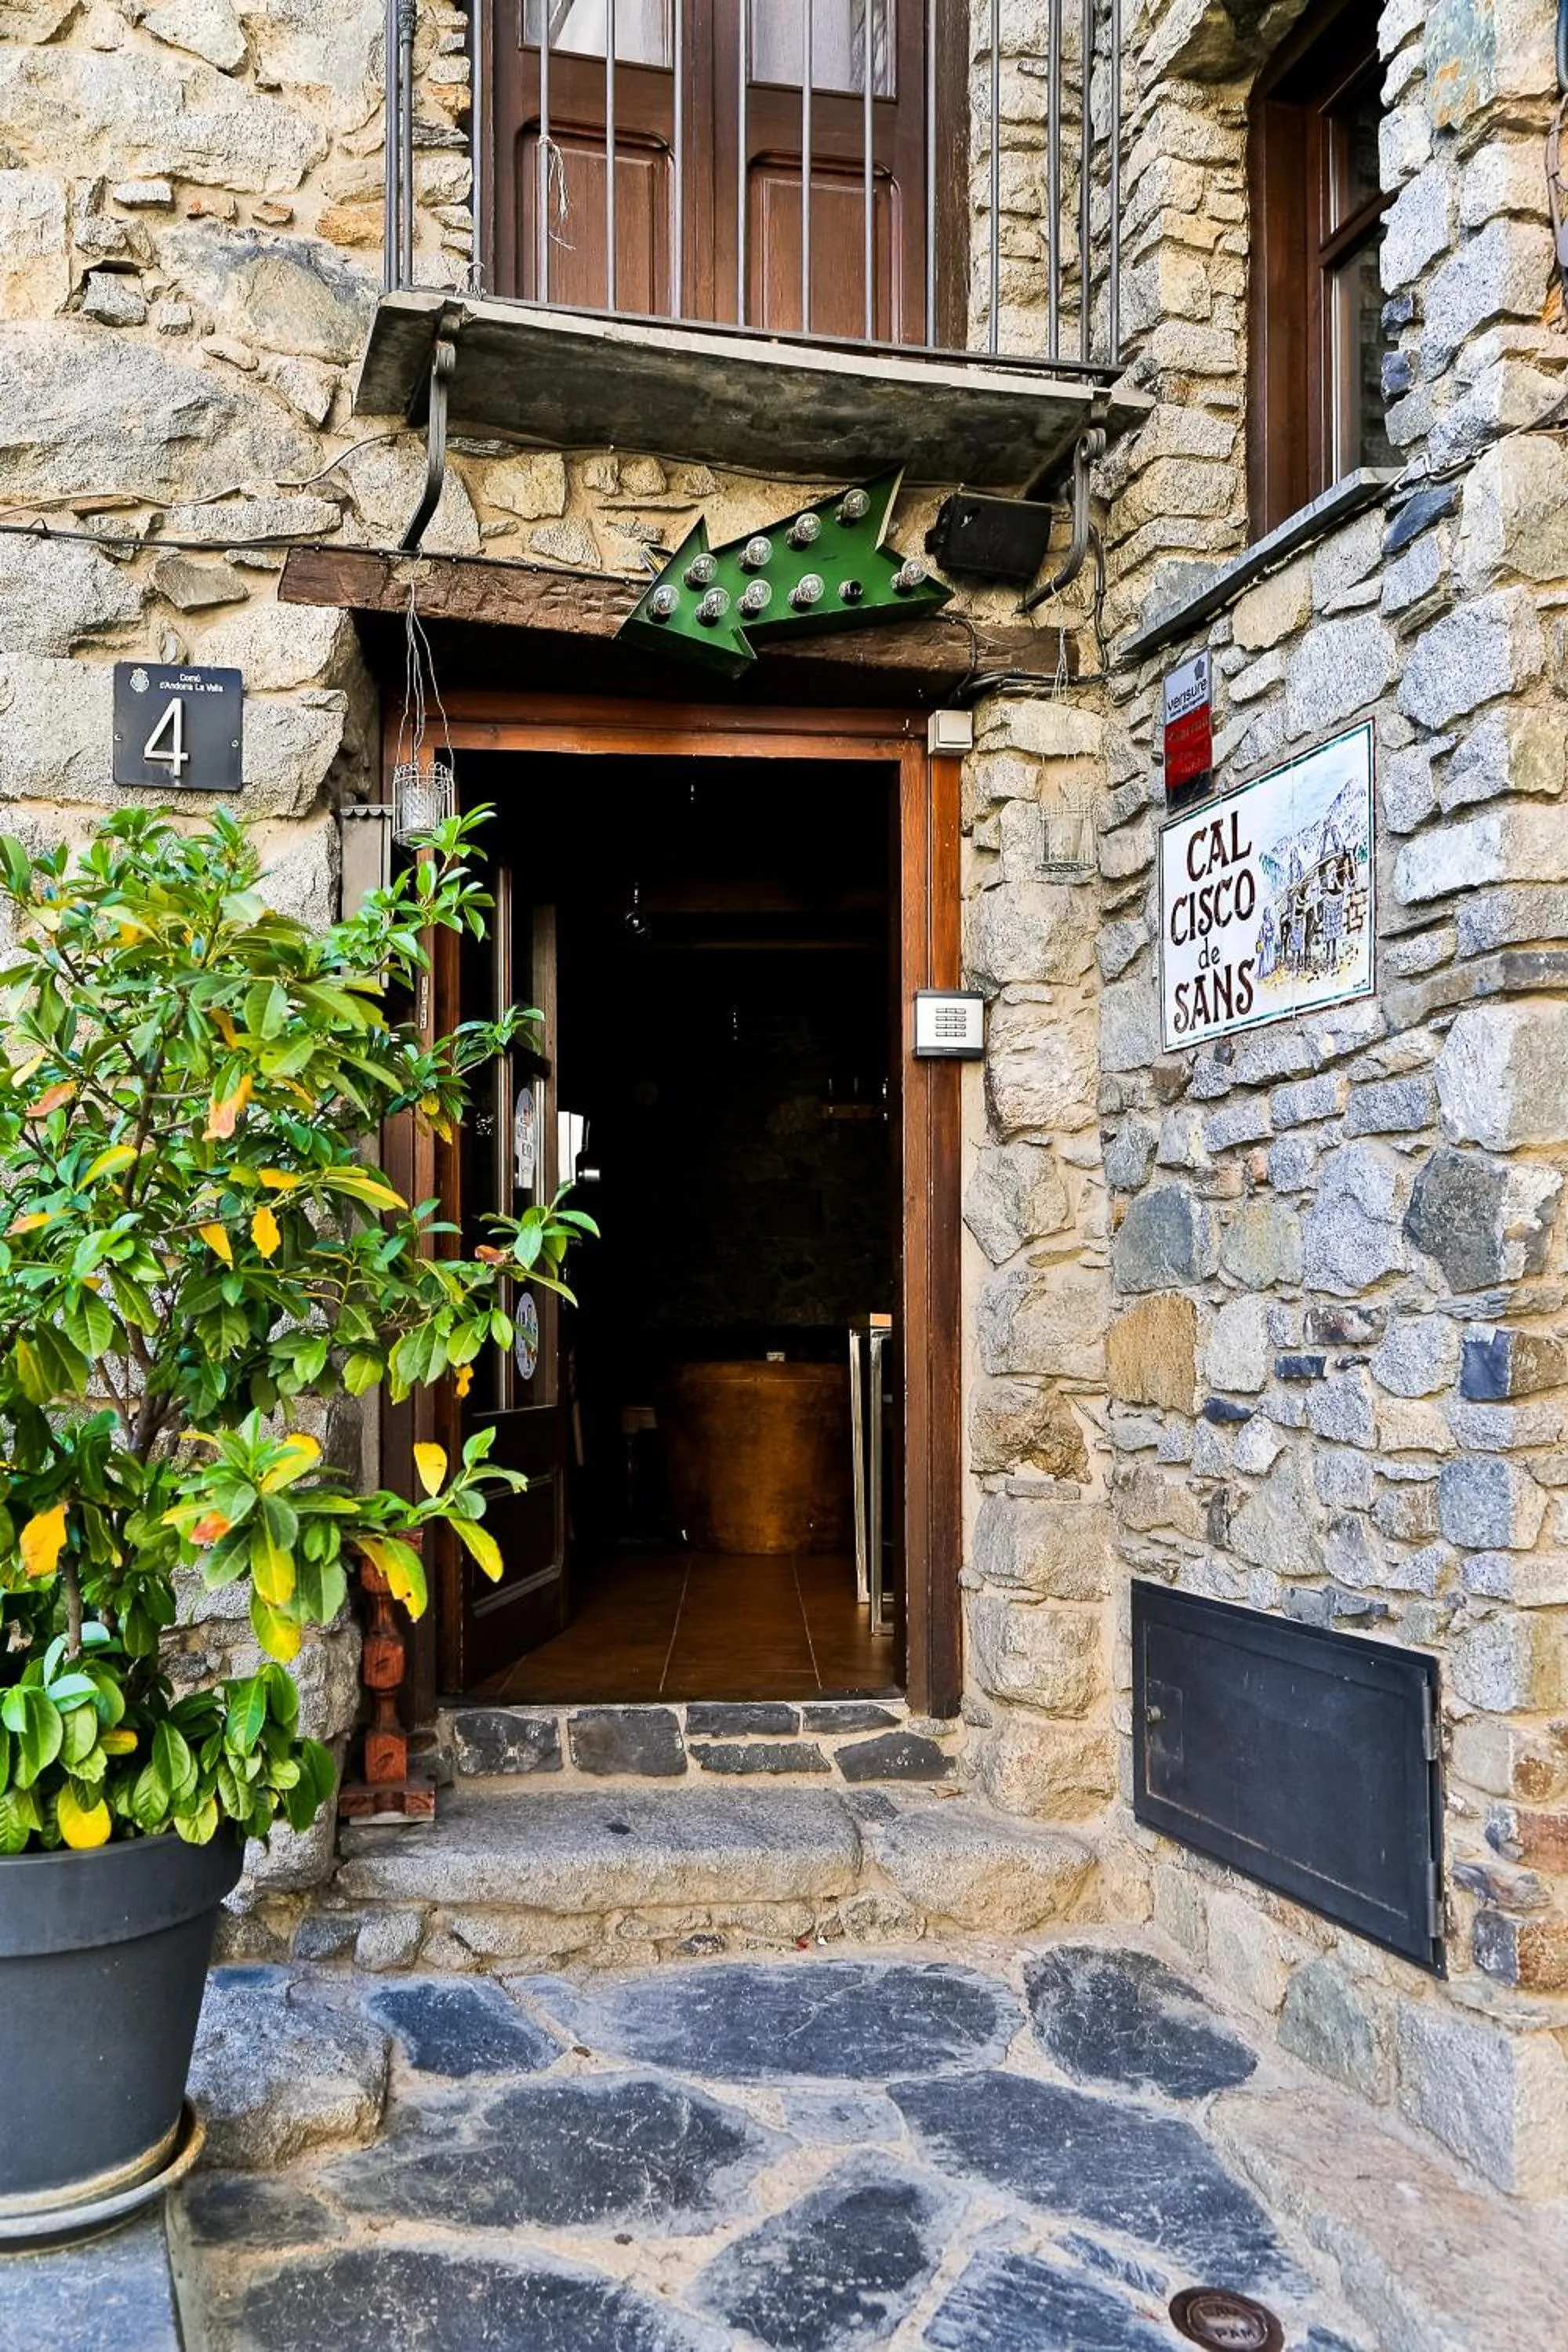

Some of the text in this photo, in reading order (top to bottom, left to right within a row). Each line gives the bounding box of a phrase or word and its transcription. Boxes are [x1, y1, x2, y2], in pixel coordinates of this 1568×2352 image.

[1167, 677, 1208, 712] verisure
[143, 697, 190, 777] 4
[1186, 811, 1252, 882] CAL
[1171, 869, 1255, 946] CISCO
[1198, 937, 1221, 970] de
[1174, 958, 1255, 1034] SANS
